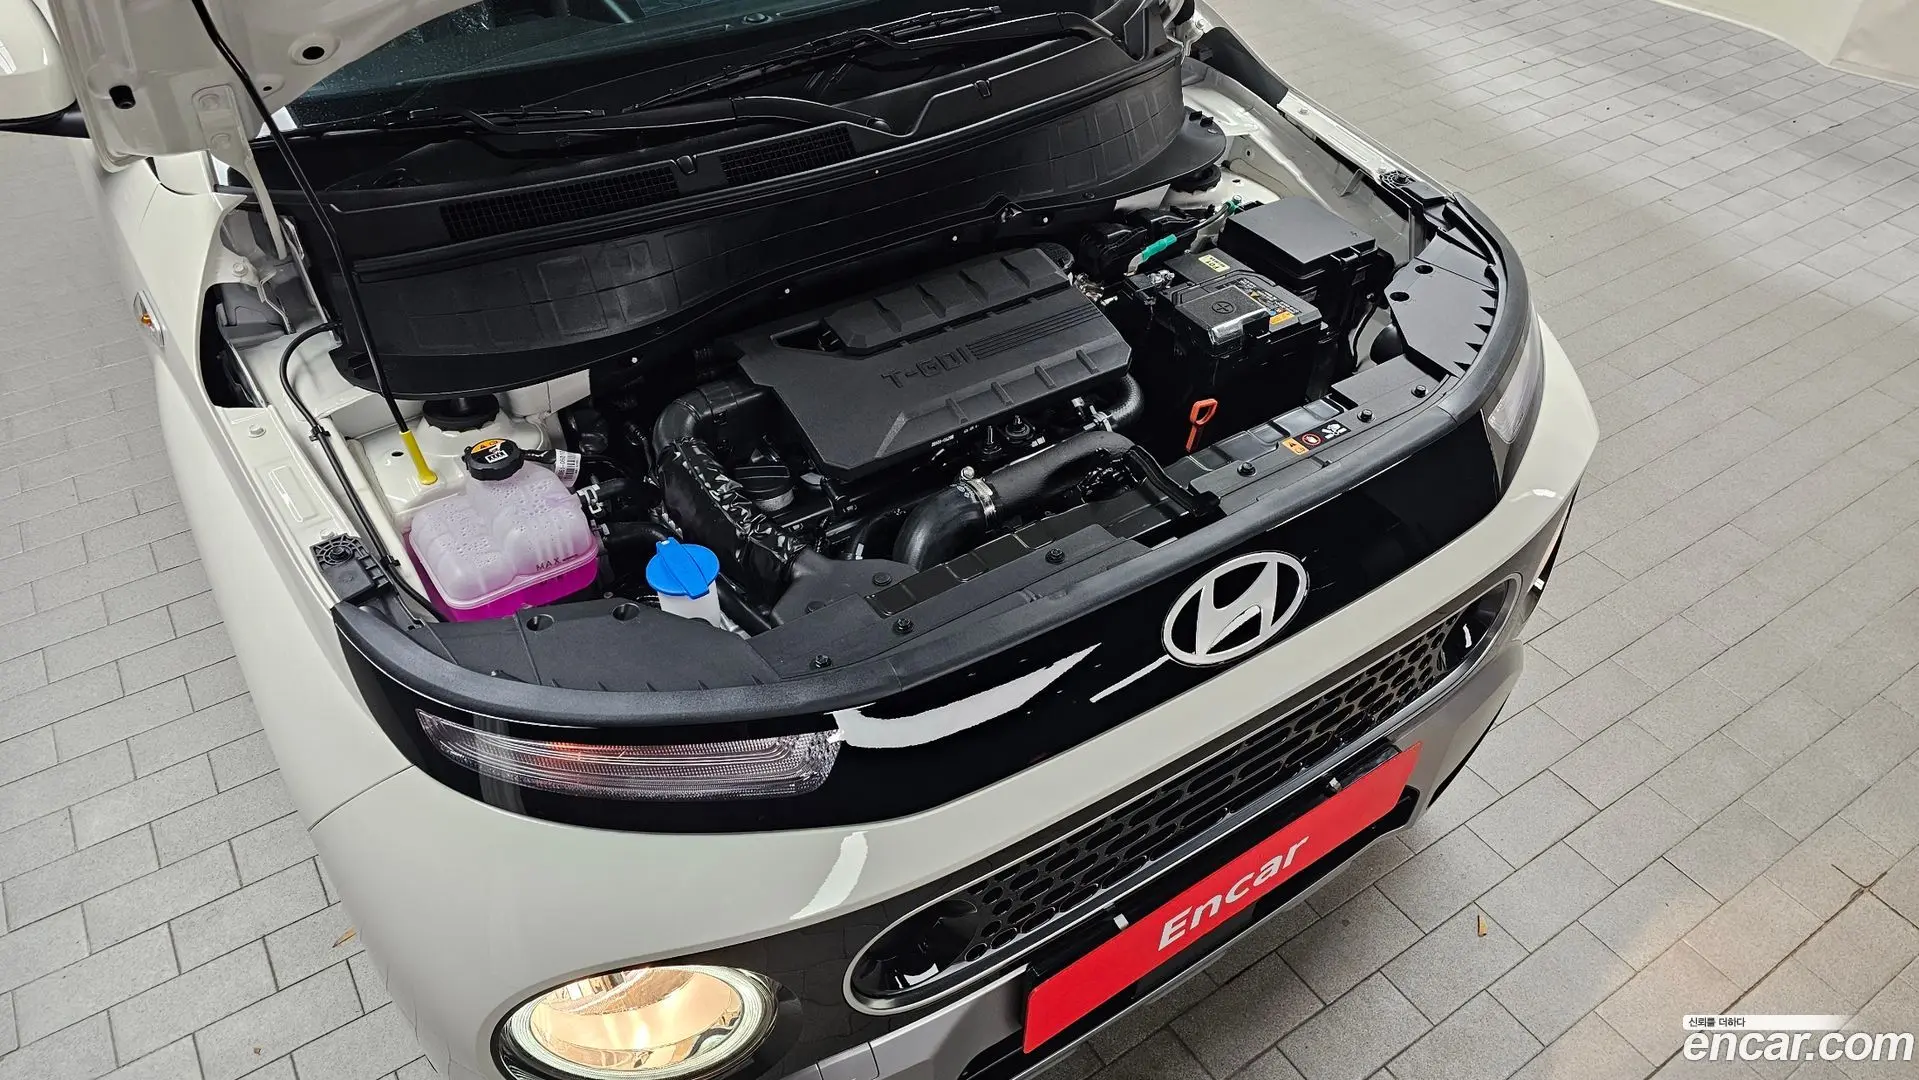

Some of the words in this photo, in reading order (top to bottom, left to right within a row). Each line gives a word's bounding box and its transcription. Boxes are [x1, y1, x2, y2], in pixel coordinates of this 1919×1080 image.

[881, 346, 972, 389] T-GDI
[535, 556, 561, 571] MAX
[1157, 835, 1310, 952] Encar
